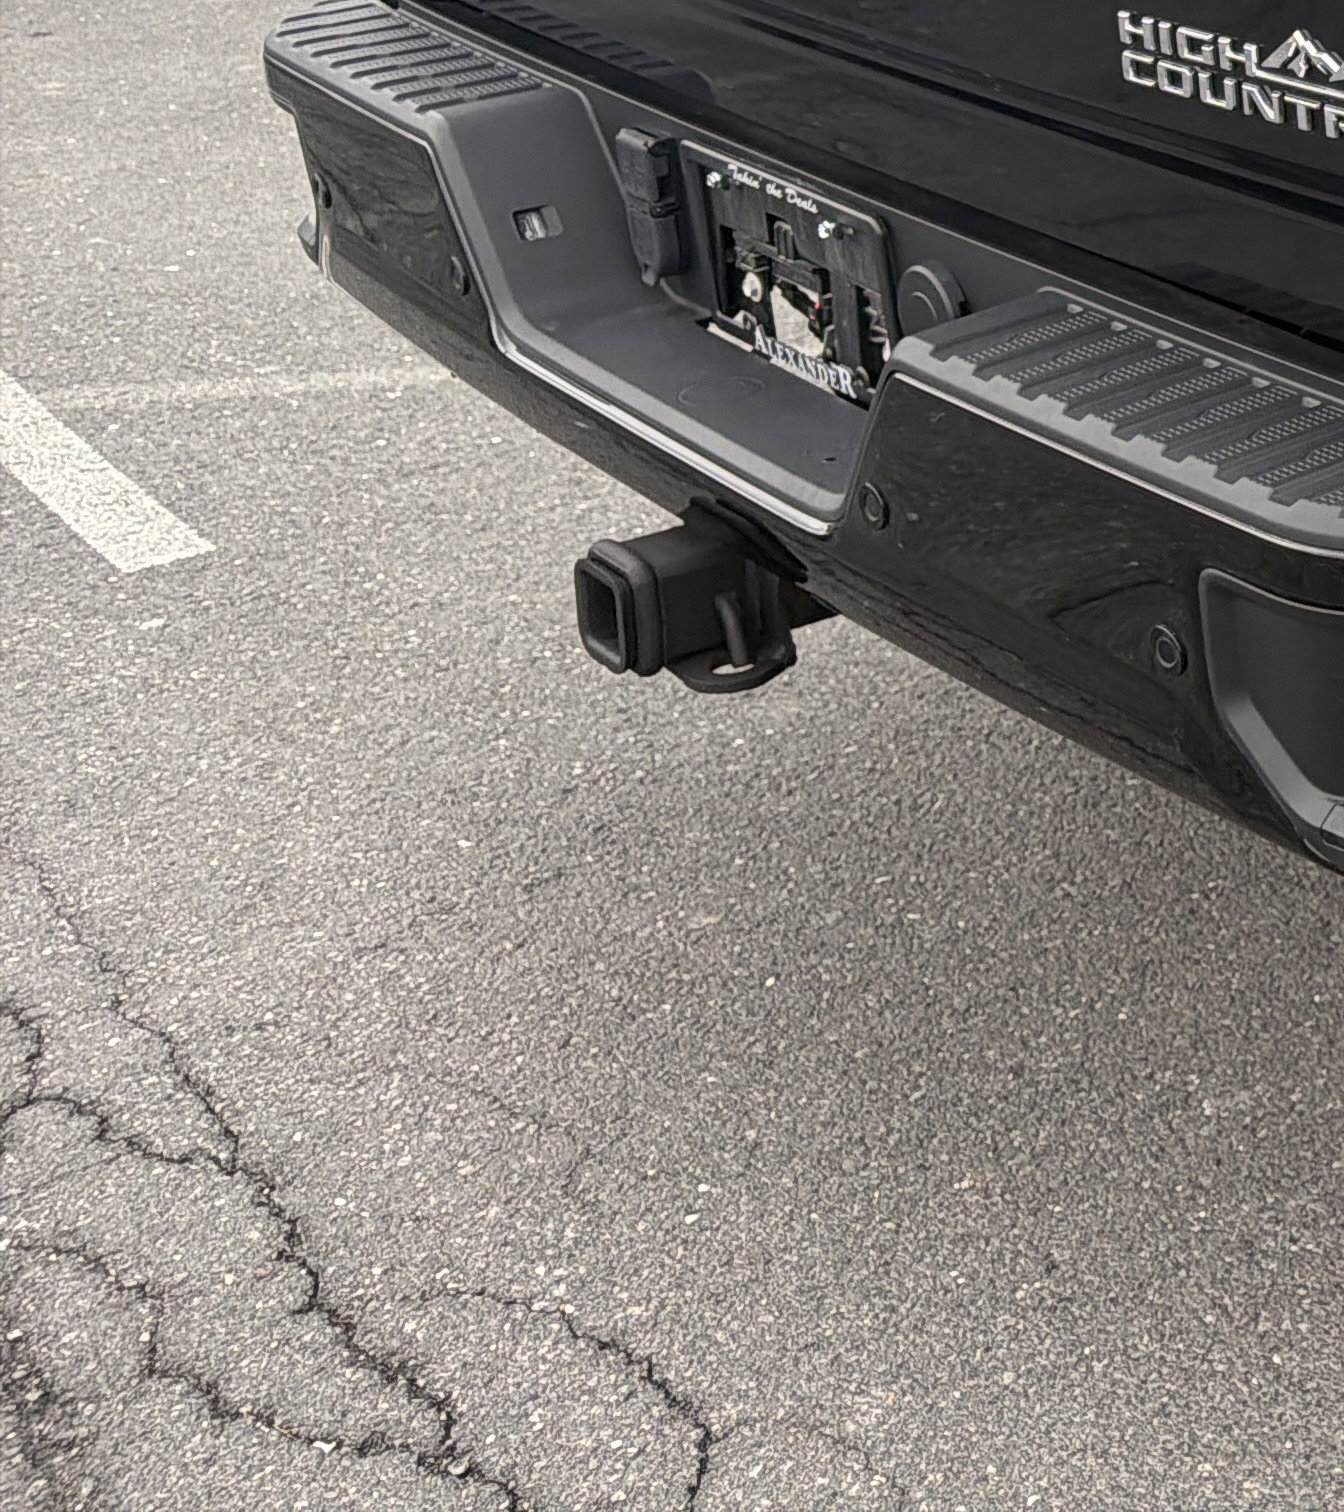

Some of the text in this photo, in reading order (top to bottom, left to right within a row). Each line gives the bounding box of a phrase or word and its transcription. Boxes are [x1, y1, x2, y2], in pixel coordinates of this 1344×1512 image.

[1117, 10, 1259, 76] HIGH
[766, 182, 783, 199] the
[785, 187, 819, 215] Deals
[754, 324, 858, 399] ALEXANDER
